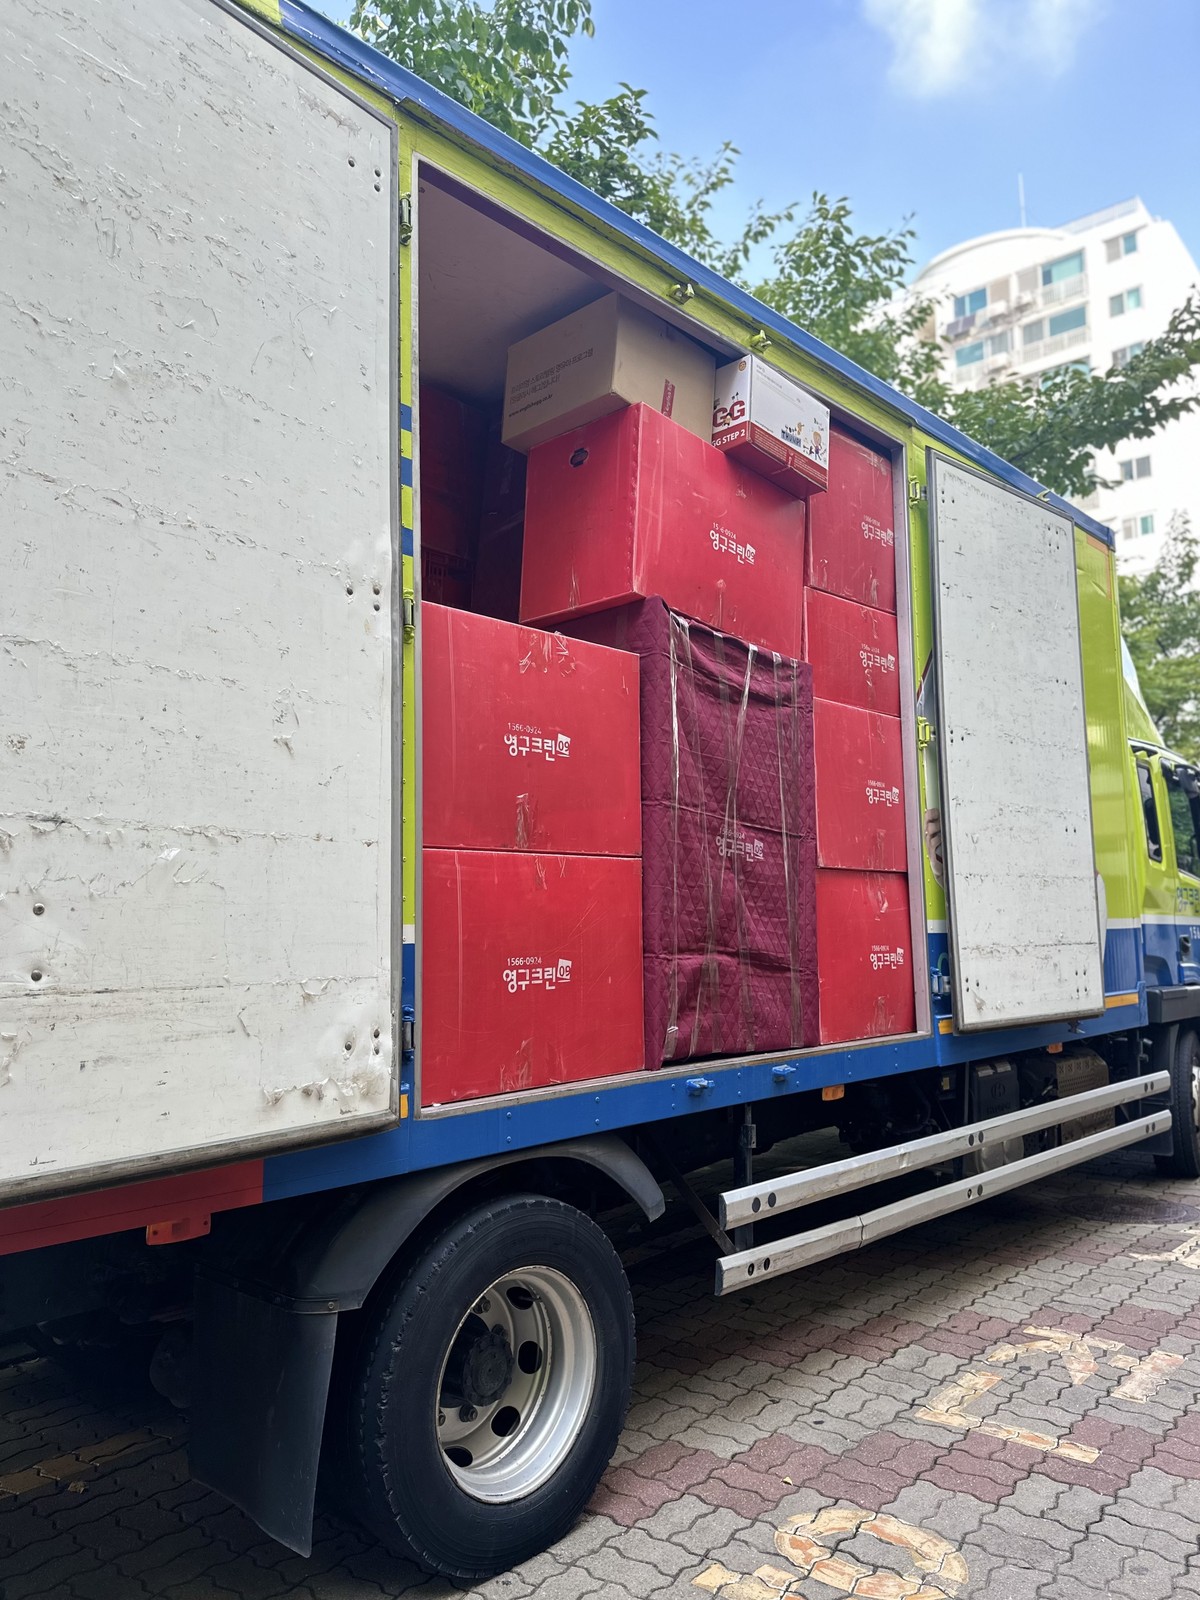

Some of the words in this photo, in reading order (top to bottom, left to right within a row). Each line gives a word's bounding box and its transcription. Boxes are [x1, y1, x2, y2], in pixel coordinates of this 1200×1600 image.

[722, 431, 739, 444] STEP
[740, 429, 746, 437] 2
[709, 530, 745, 564] 영구크린
[503, 733, 555, 762] 영구크린
[507, 956, 542, 967] 1566-0924
[502, 967, 556, 993] 영구크린
